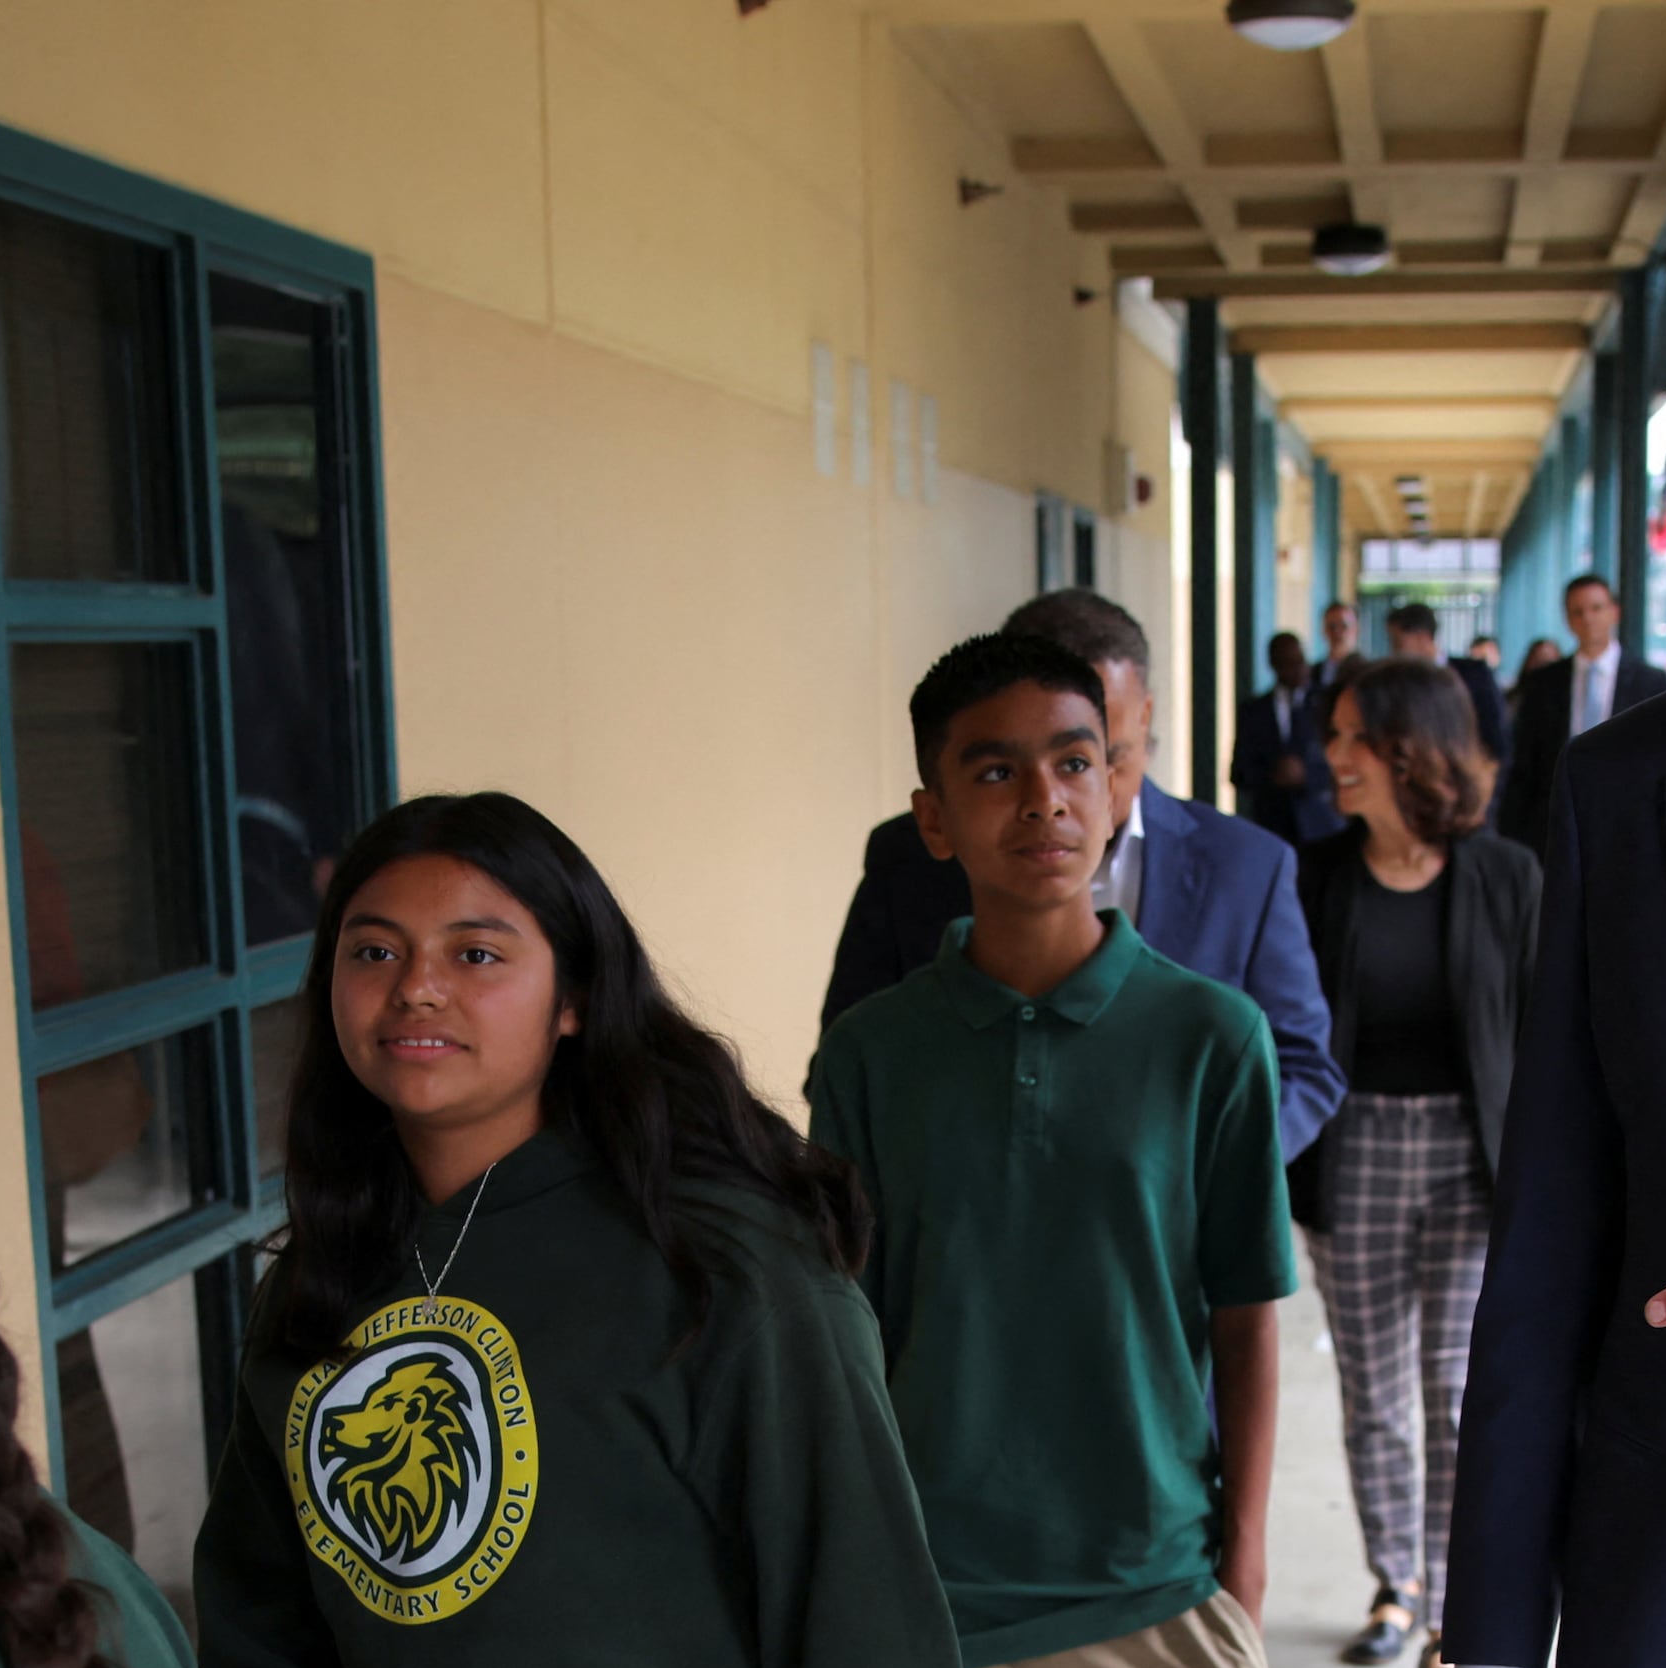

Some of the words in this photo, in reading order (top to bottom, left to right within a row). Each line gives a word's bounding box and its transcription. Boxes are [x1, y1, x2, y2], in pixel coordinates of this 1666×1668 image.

[288, 1354, 346, 1449] WILLIA
[362, 1304, 481, 1347] JEFFERSON
[476, 1326, 528, 1429] CLINTON
[296, 1500, 441, 1617] ELEMENTARY
[454, 1482, 531, 1601] SCHOOL
